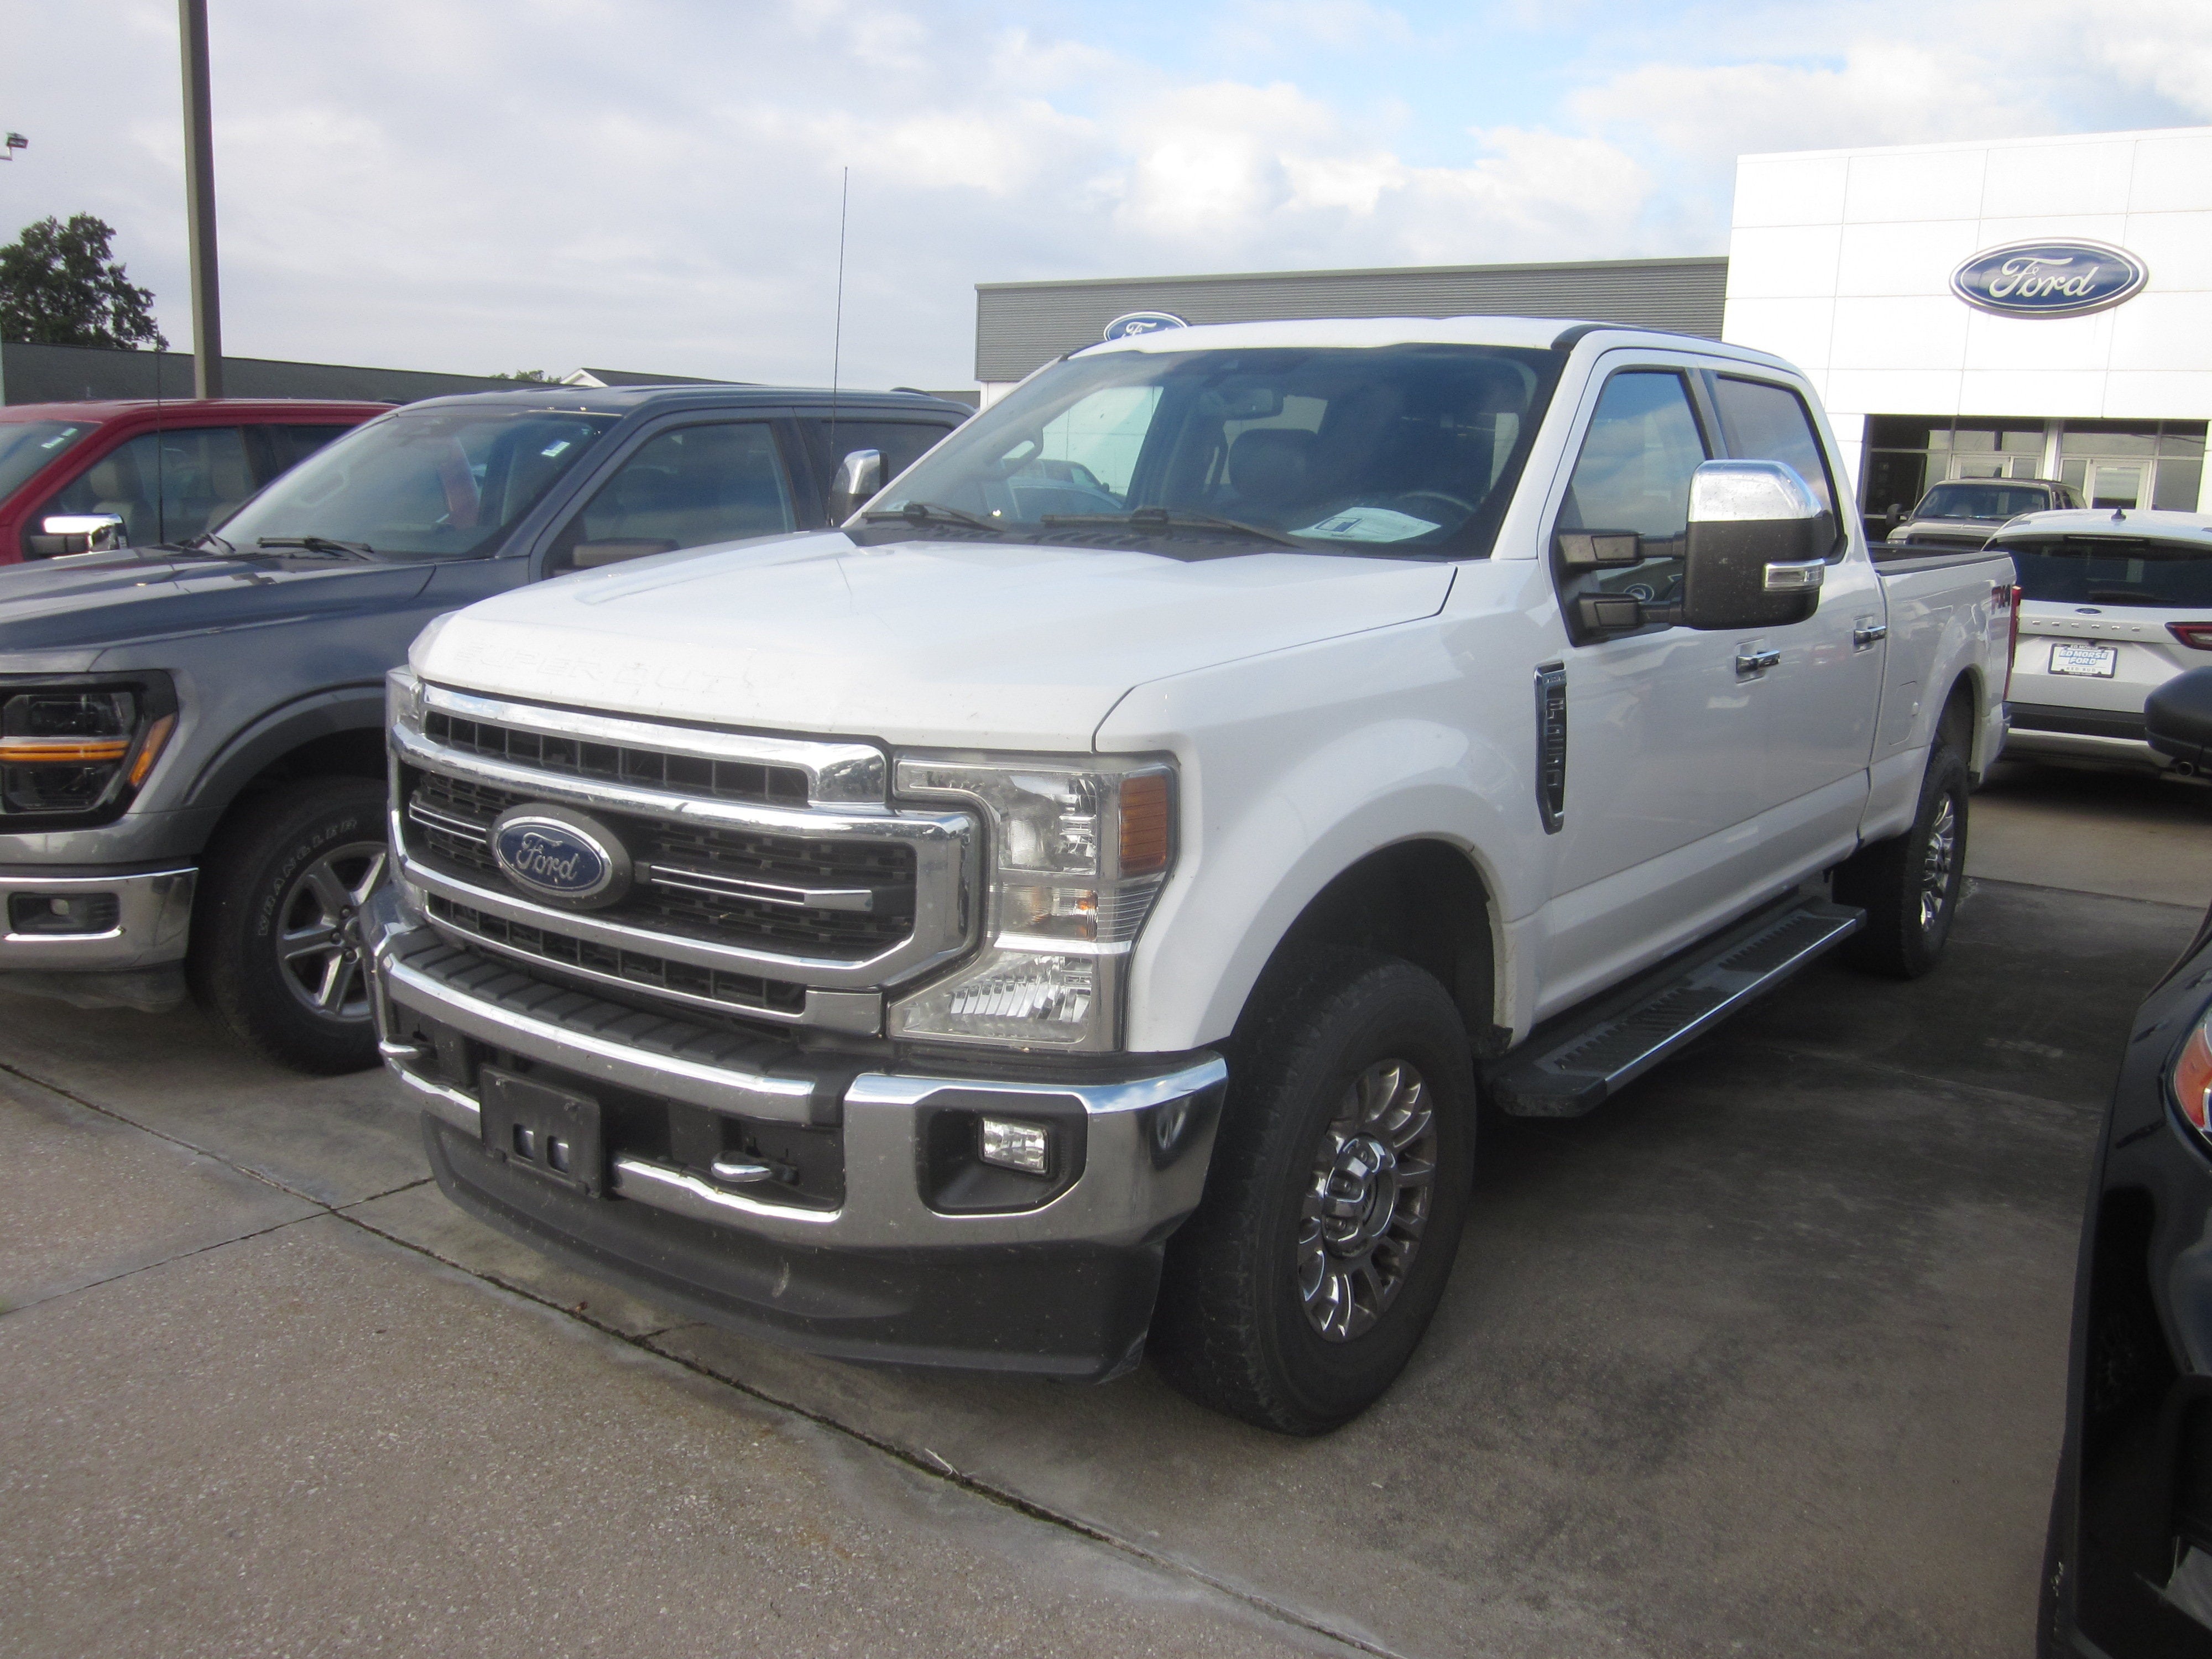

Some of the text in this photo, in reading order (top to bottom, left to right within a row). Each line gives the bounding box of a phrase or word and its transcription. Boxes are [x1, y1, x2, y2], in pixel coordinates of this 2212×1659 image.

[1989, 257, 2100, 298] Ford
[455, 644, 603, 681] SUPER
[257, 818, 357, 936] WRANGLER
[516, 832, 580, 880] Ford
